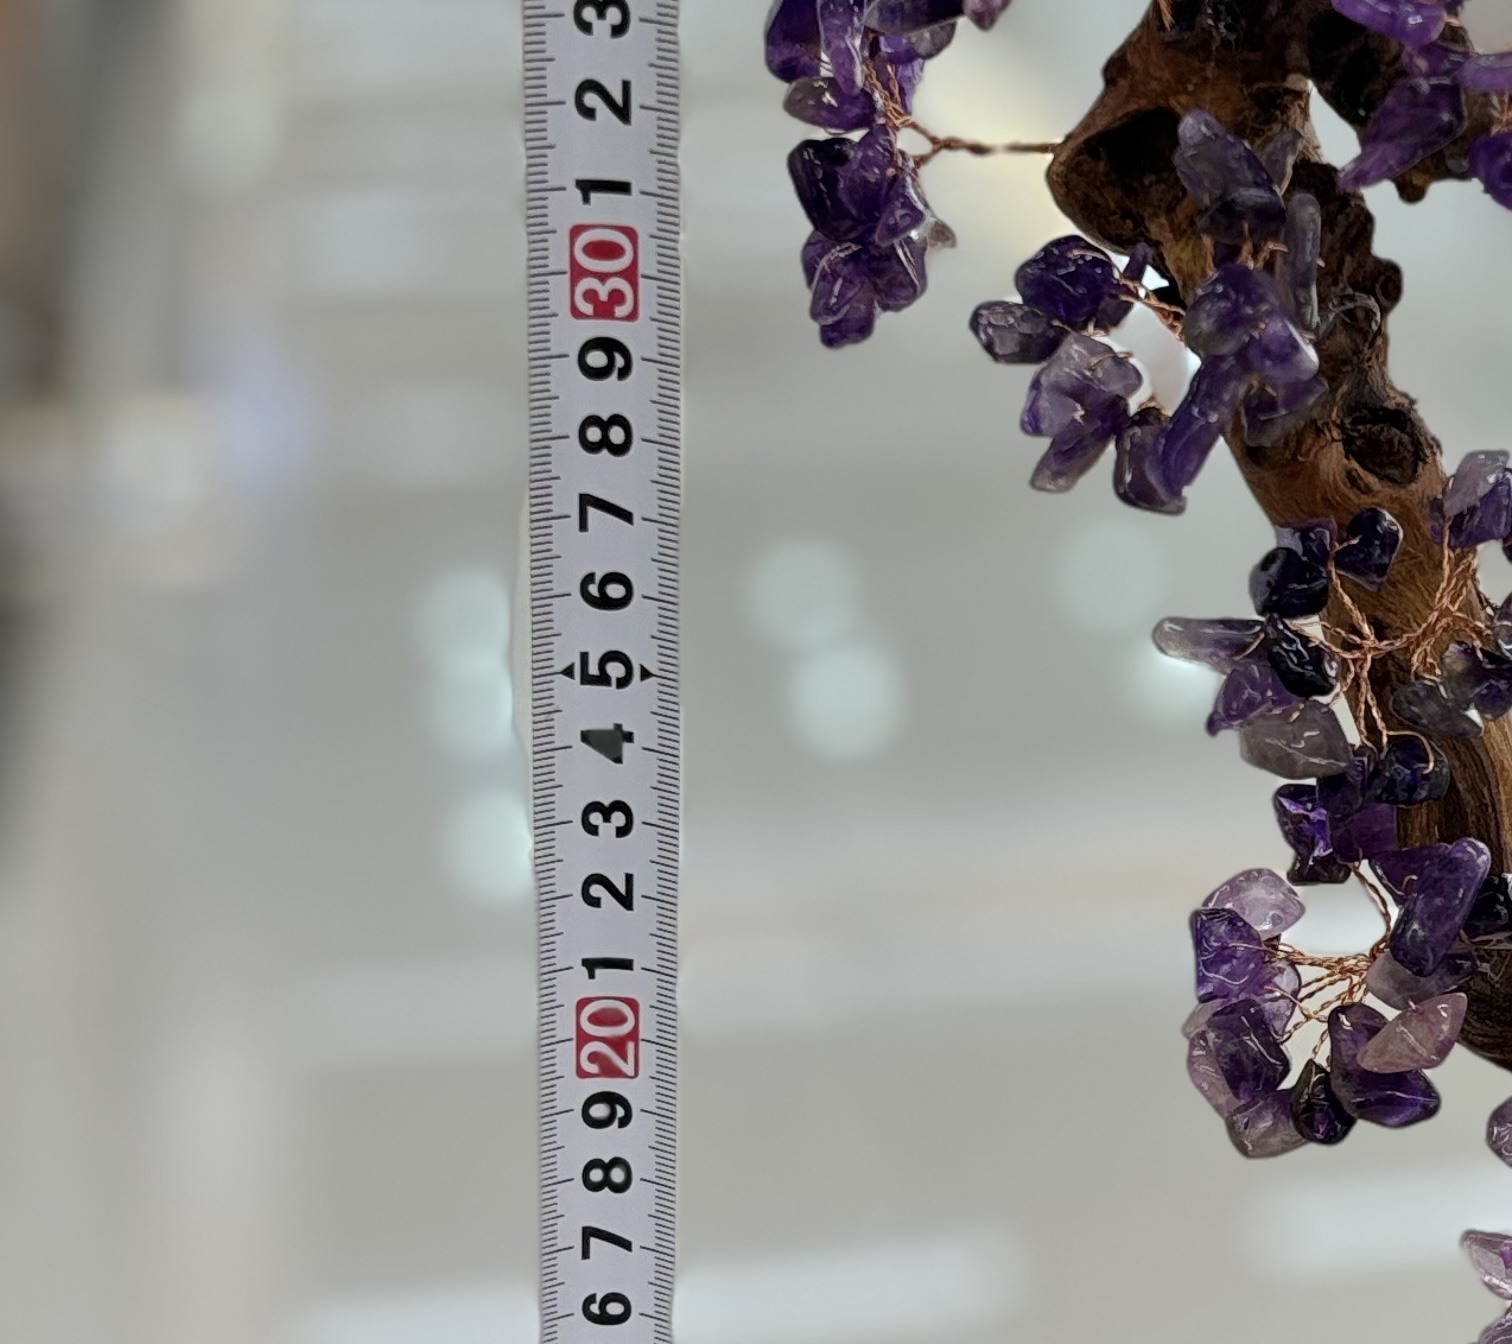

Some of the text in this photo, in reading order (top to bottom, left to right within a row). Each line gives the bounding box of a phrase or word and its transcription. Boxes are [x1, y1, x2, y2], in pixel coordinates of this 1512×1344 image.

[574, 77, 632, 127] 2
[574, 177, 632, 206] 1
[573, 227, 635, 318] 30
[576, 335, 634, 383] 9
[577, 412, 634, 459] 8
[578, 491, 634, 534] 7
[579, 570, 634, 613] 6
[579, 648, 634, 691] 5
[580, 721, 635, 766] 4
[580, 798, 634, 840] 3
[580, 871, 635, 913] 2
[581, 955, 635, 981] 1
[579, 998, 636, 1077] 20
[581, 1089, 633, 1131] 9
[581, 1155, 633, 1195] 8
[581, 1224, 633, 1262] 7
[581, 1290, 632, 1327] 6
